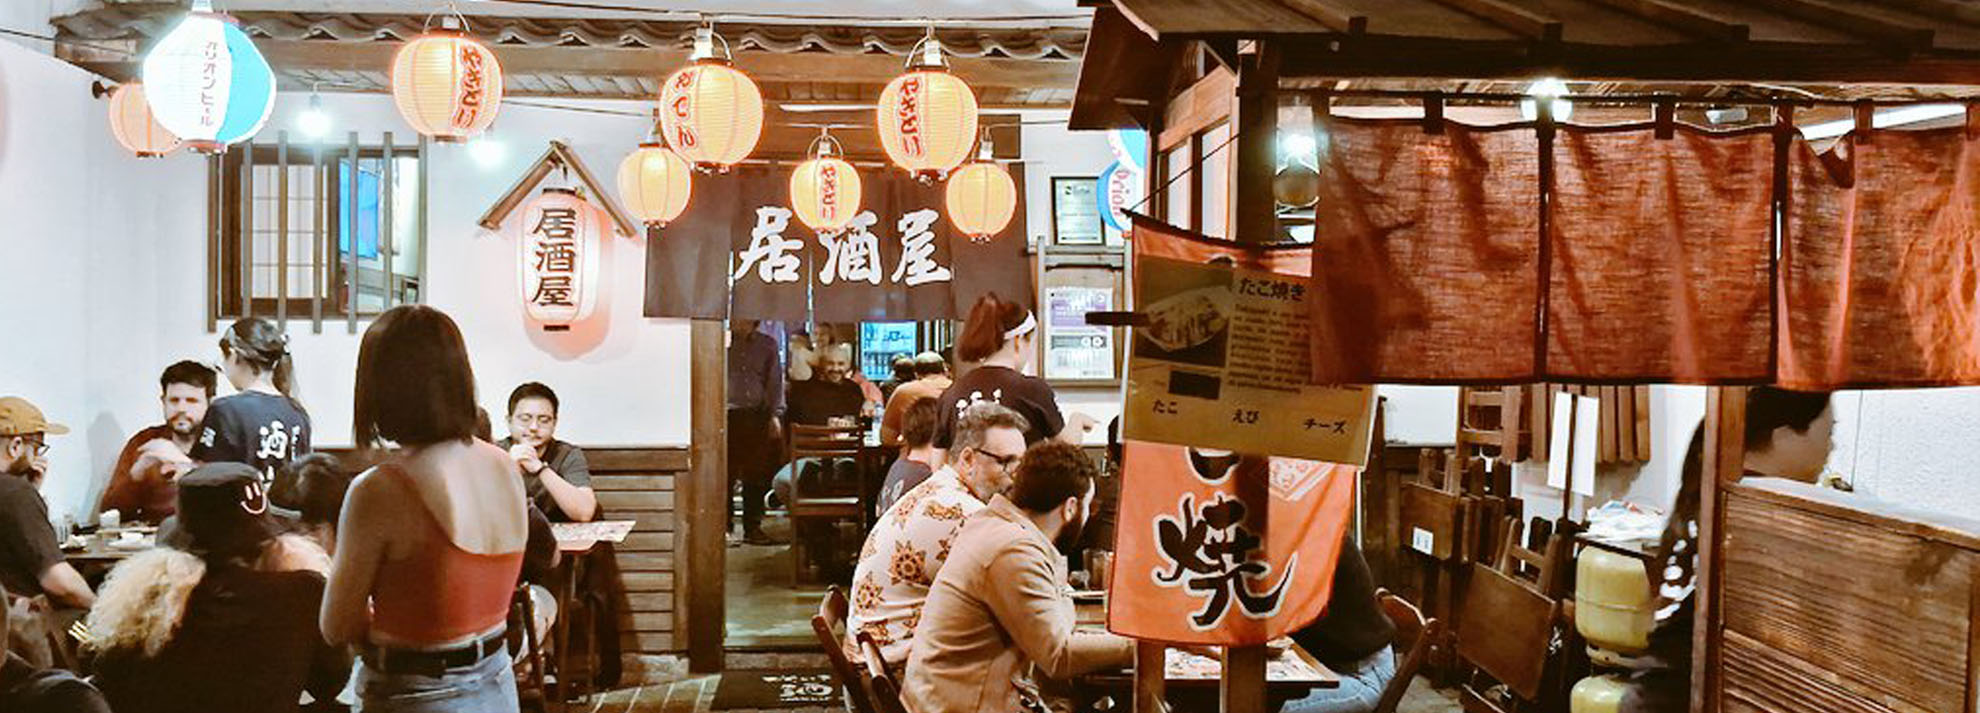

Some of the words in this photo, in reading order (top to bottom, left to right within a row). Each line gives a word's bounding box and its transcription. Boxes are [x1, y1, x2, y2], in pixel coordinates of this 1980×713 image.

[453, 45, 482, 128] やきとり
[900, 78, 921, 156] やきとり
[822, 167, 836, 220] やきとり
[531, 207, 577, 306] 居酒屋
[734, 206, 952, 286] 居酒屋
[1152, 399, 1179, 415] たこ
[1232, 408, 1260, 425] えび
